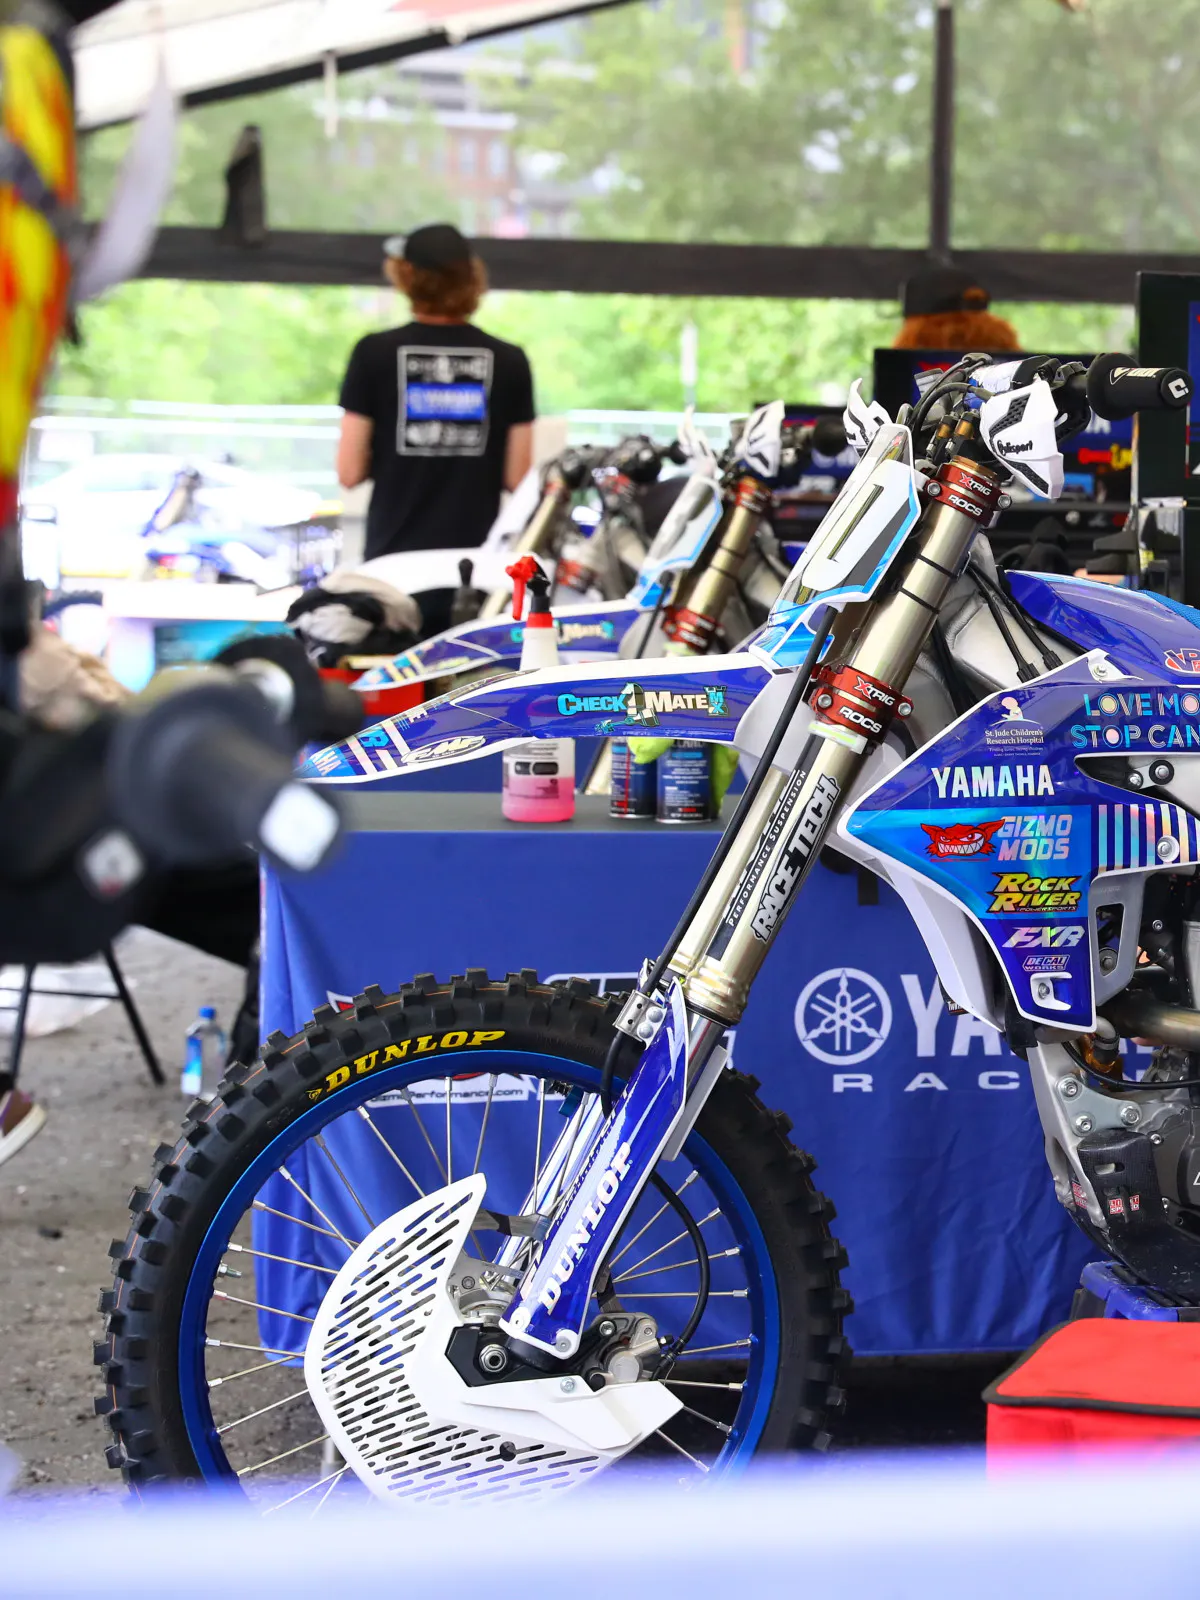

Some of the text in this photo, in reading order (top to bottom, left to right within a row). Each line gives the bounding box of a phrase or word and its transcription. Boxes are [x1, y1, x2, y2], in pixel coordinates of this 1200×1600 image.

[960, 472, 992, 496] XTRIG
[948, 494, 983, 516] ROCS
[556, 692, 627, 717] CHECK
[643, 690, 709, 713] MATE
[855, 676, 896, 707] XTRIG
[1083, 691, 1154, 717] LOVE
[838, 706, 882, 733] ROCS
[995, 729, 1010, 738] Jude
[1010, 728, 1043, 736] Children's
[1017, 736, 1044, 746] Hospital
[1069, 723, 1142, 749] STOP
[931, 764, 1056, 799] YAMAHA
[997, 814, 1073, 838] GIZMO
[727, 845, 771, 928] PERFORMANCE
[769, 770, 807, 842] SUSPENSION
[752, 855, 802, 942] RACE
[794, 774, 839, 857] TECH
[997, 837, 1071, 861] MODS
[992, 872, 1078, 892] ROCK
[987, 892, 1082, 913] RIVER
[1001, 925, 1086, 948] FXR
[1027, 955, 1068, 966] DECAL
[325, 1029, 506, 1093] DUNLOP
[538, 1141, 632, 1316] DUNLOP
